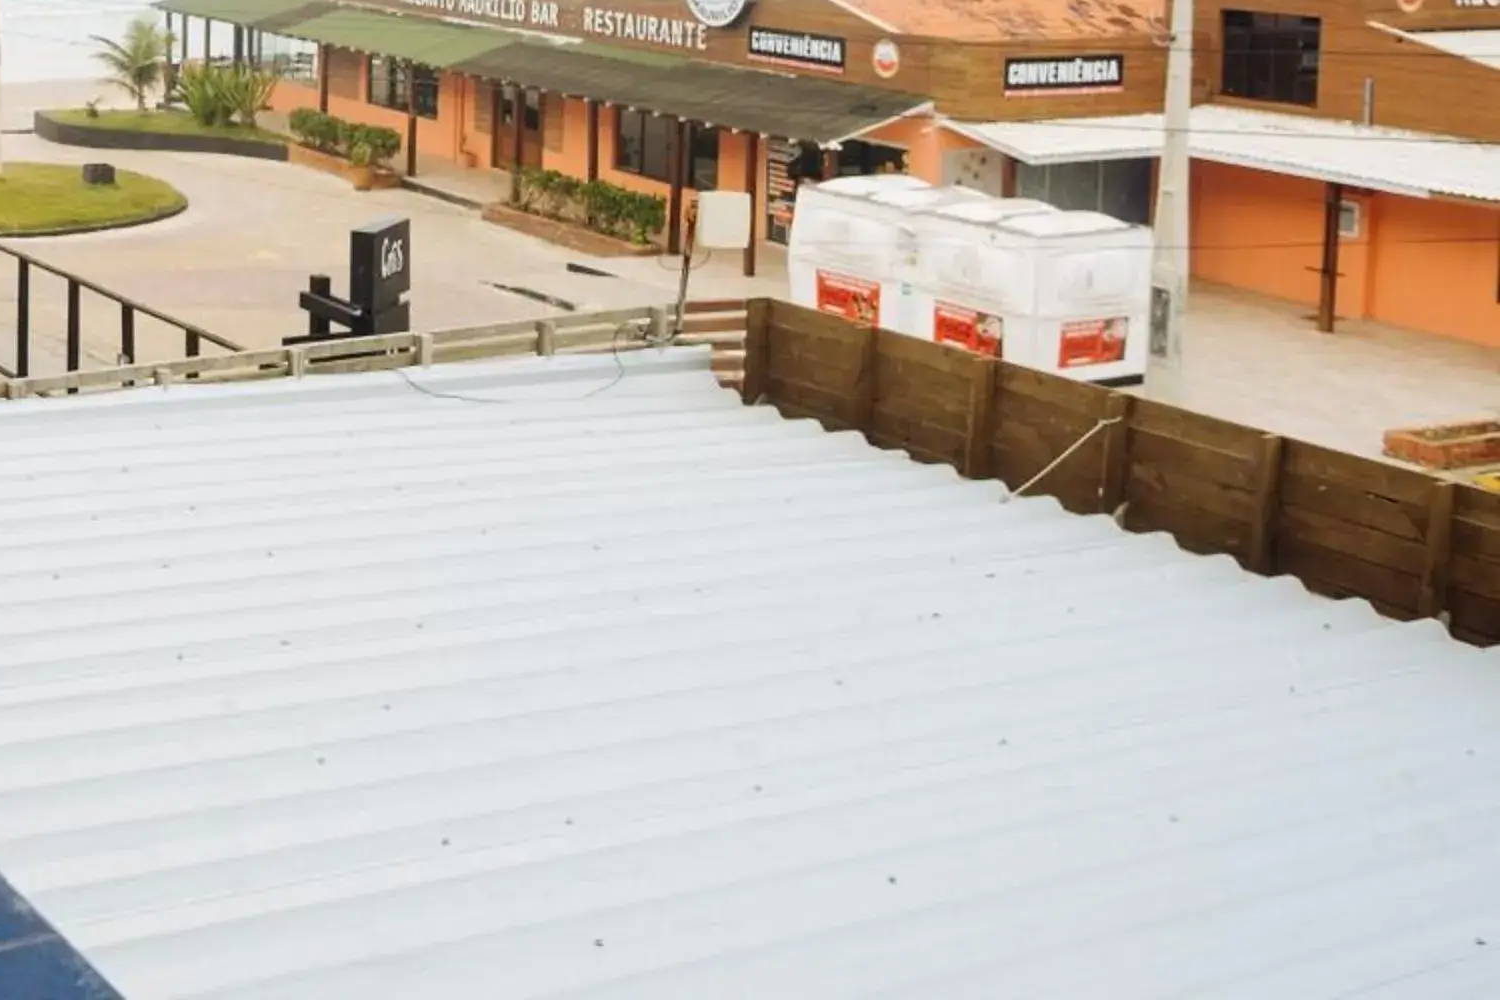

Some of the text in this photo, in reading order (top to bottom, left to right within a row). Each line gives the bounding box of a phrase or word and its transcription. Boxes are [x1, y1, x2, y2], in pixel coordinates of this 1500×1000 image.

[531, 0, 560, 28] BAR
[583, 6, 708, 51] RESTAURANTE
[751, 30, 843, 63] CONVENIÊNCIA
[1007, 57, 1120, 86] CONVENIÊNCIA
